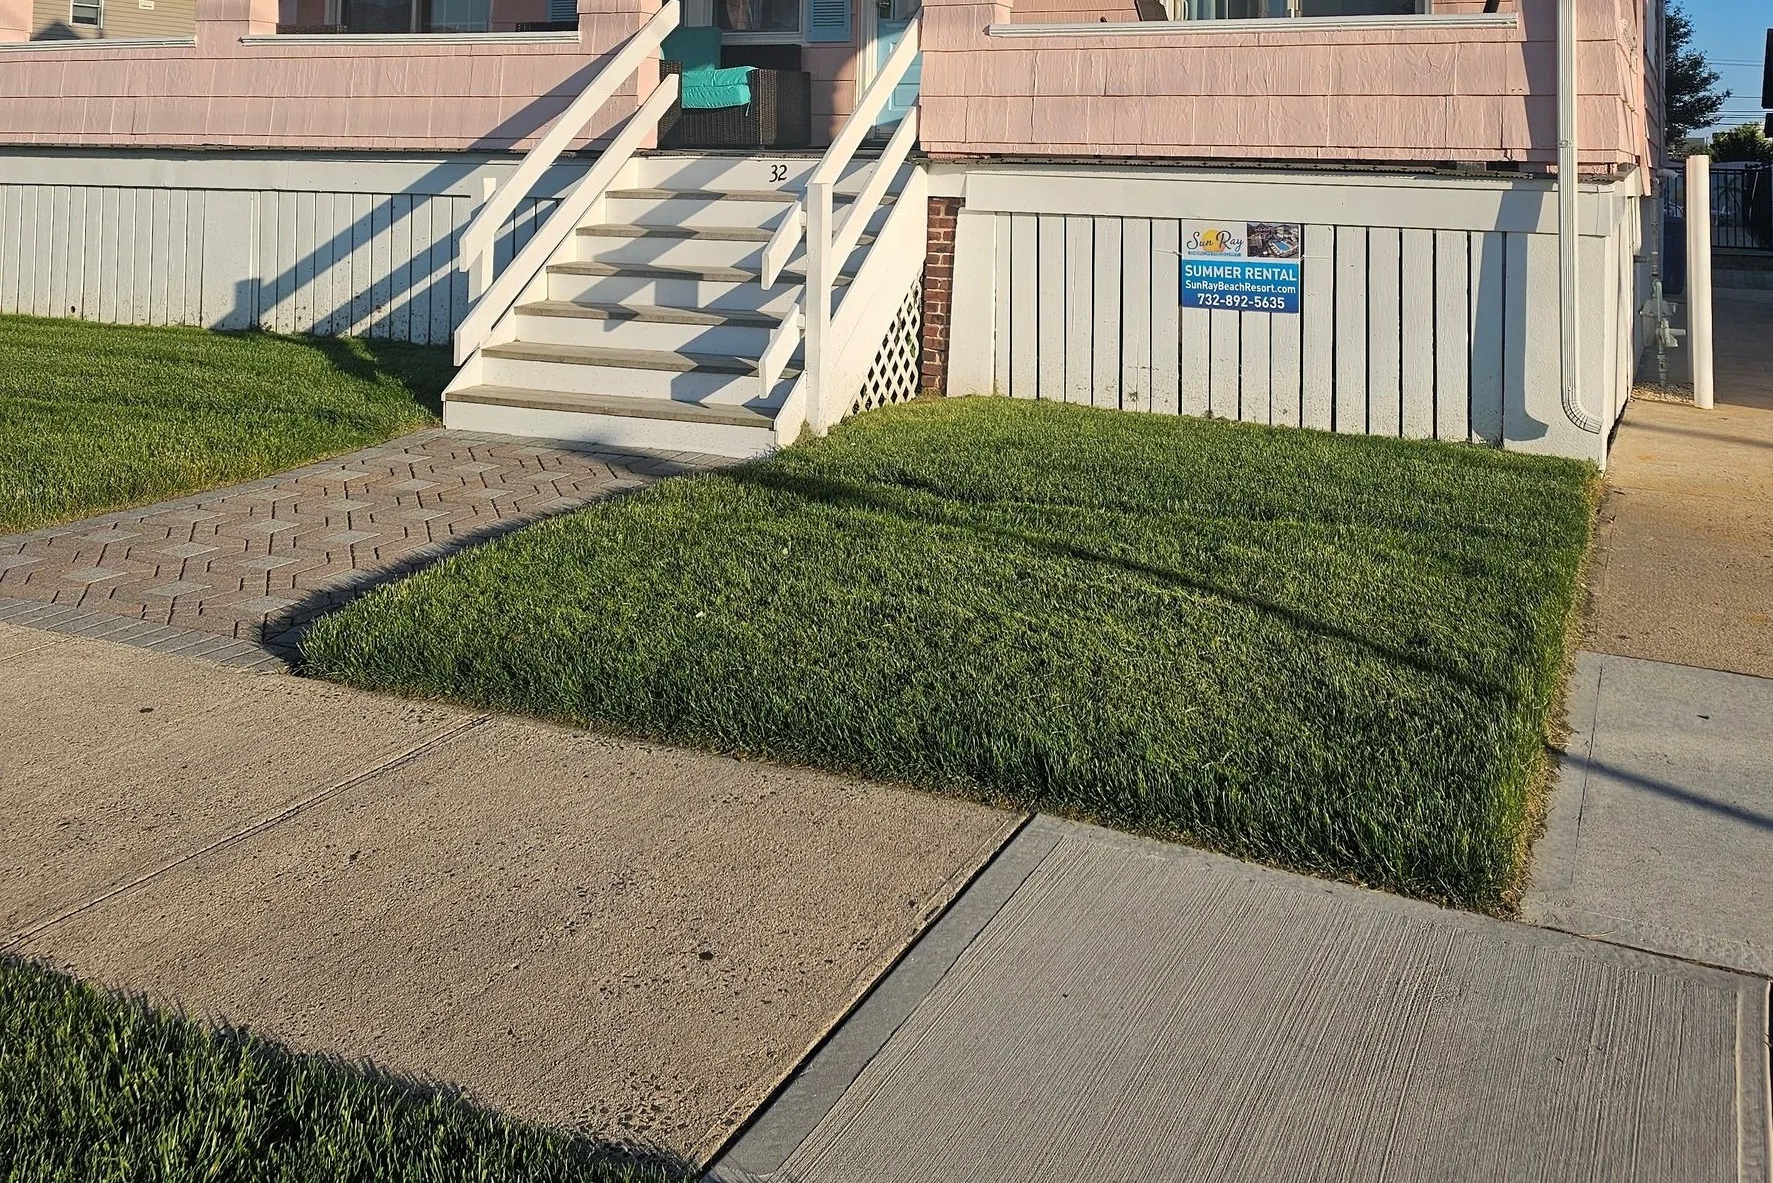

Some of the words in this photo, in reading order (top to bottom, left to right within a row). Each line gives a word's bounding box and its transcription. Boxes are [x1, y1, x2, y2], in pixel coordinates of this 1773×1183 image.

[769, 164, 787, 182] 32
[1186, 231, 1213, 250] Sun
[1215, 230, 1243, 252] Ray
[1185, 265, 1241, 279] SUMMER
[1245, 267, 1297, 281] RENTAL
[1185, 280, 1296, 294] SunRayBeachResort.com
[1197, 293, 1285, 309] 732-892-5635
